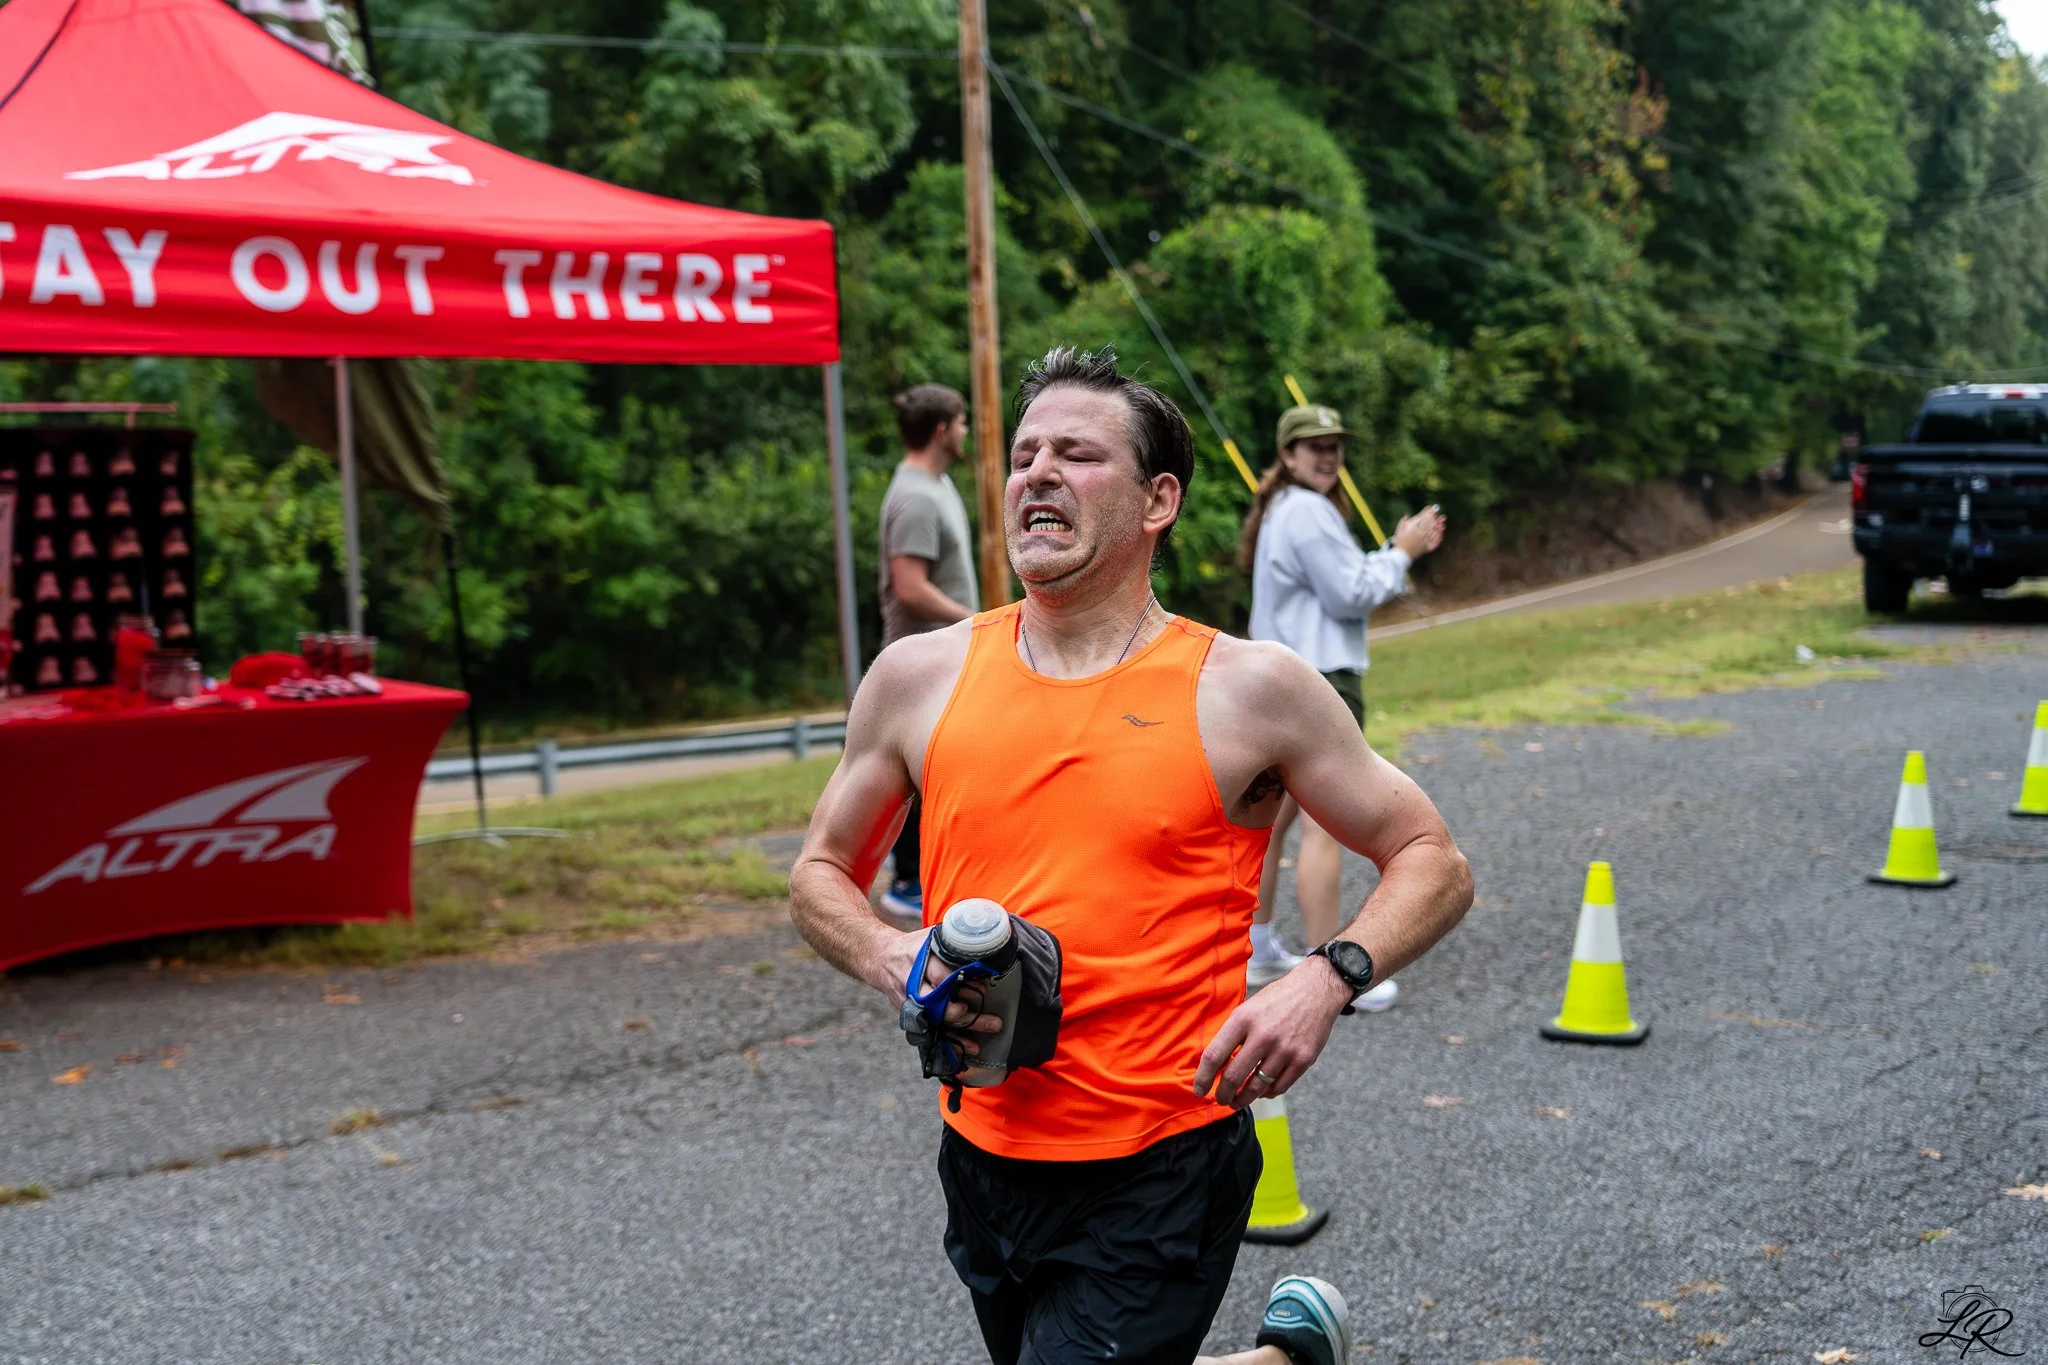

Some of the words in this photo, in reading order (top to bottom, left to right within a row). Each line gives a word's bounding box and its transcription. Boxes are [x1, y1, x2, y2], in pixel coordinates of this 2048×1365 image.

[63, 136, 474, 186] ALTRA
[230, 235, 445, 316] OUT
[22, 823, 338, 895] ALTRA
